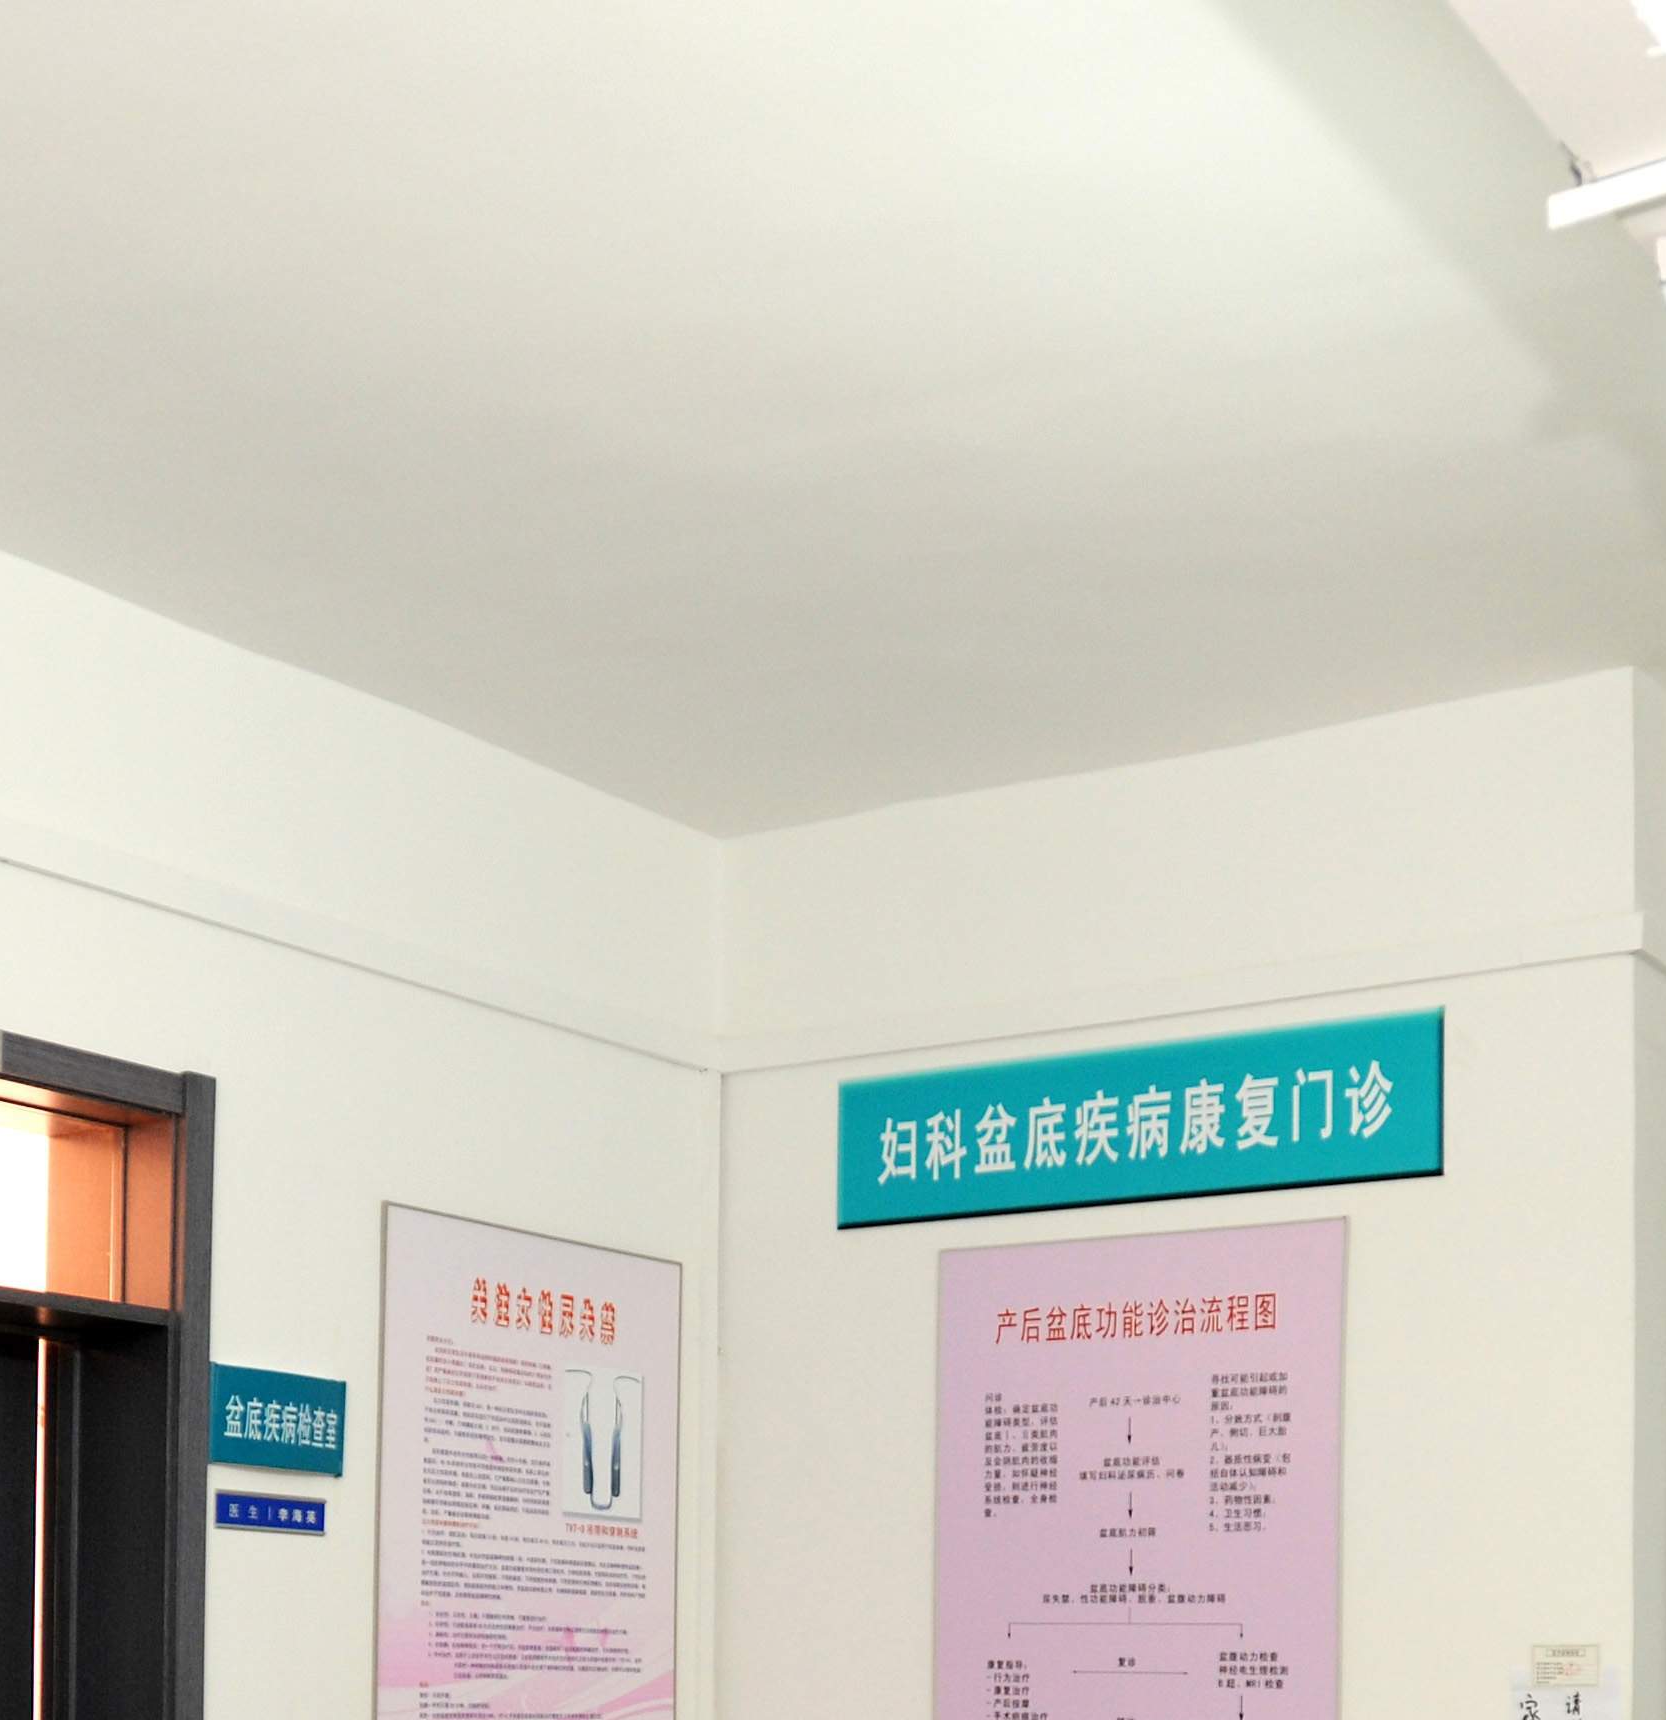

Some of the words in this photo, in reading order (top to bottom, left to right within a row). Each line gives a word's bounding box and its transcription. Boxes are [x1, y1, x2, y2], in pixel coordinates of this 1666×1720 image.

[878, 1059, 1394, 1187] 妇科盆底疾病康复门诊
[470, 1276, 616, 1345] 关注女性尿失禁
[995, 1292, 1276, 1345] 产后盆底功能诊治流程图
[224, 1395, 339, 1450] 盆底疾病检查室
